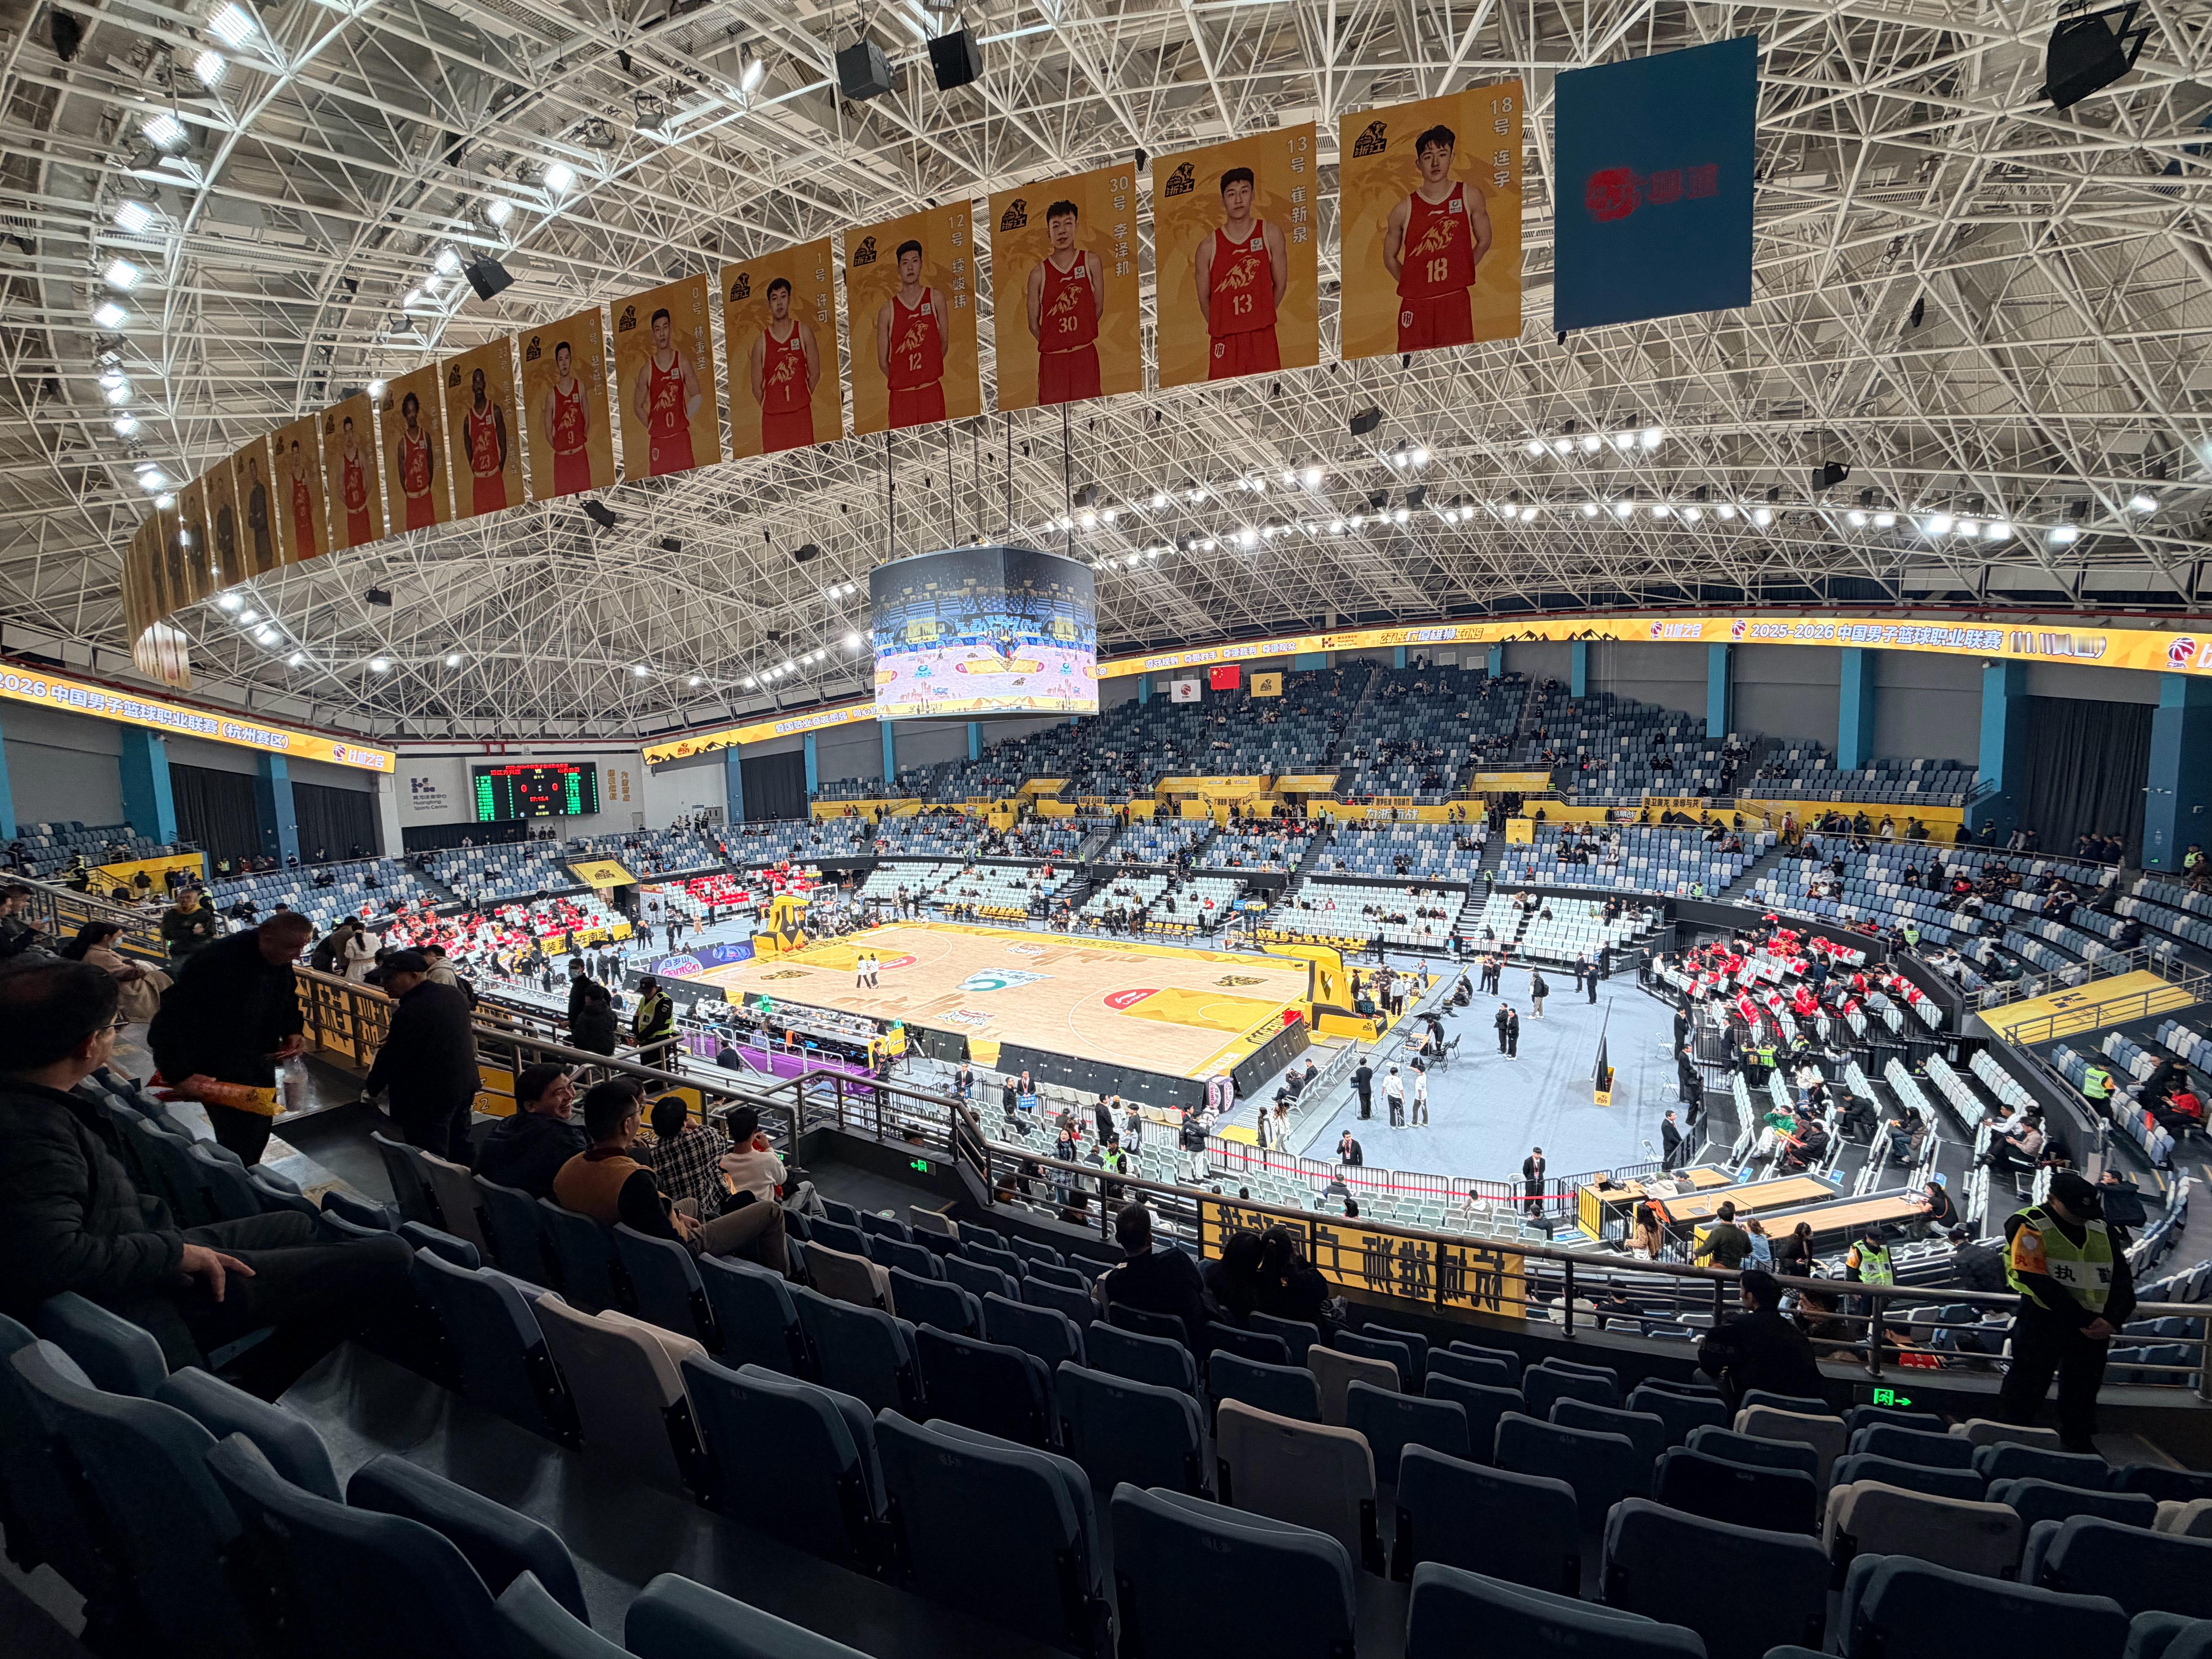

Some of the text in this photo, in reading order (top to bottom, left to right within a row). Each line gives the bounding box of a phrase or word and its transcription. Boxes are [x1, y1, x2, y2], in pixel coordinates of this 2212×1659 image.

[1490, 97, 1513, 188] 18号 连宇
[1287, 136, 1308, 244] 13号 崔新泉
[948, 214, 965, 247] 12号
[1109, 176, 1130, 278] 30号 李泽邦
[1426, 257, 1448, 283] 18
[815, 252, 828, 324] 1号 许可
[692, 287, 702, 315] 0号
[1233, 294, 1252, 315] 13
[589, 319, 598, 345] 9号
[1058, 316, 1078, 333] 30
[909, 352, 922, 371] 12
[785, 385, 790, 402] 1
[665, 411, 674, 428] 0
[567, 431, 574, 444] 9
[479, 455, 491, 469] 23
[1406, 628, 1457, 641] 广厦雄狮
[1750, 623, 1835, 640] 2025-2026
[1837, 624, 2003, 650] 中国男子篮球职业联赛
[1144, 641, 1297, 669] 遵守规则 尊重对手 尊重裁判 尊重观众
[50, 685, 218, 735] 中国男子篮球职业联赛
[775, 711, 848, 734] 爱国敬业奋发图强
[520, 782, 558, 793] 0 0
[664, 956, 689, 967] 百岁山
[479, 1097, 489, 1111] 2
